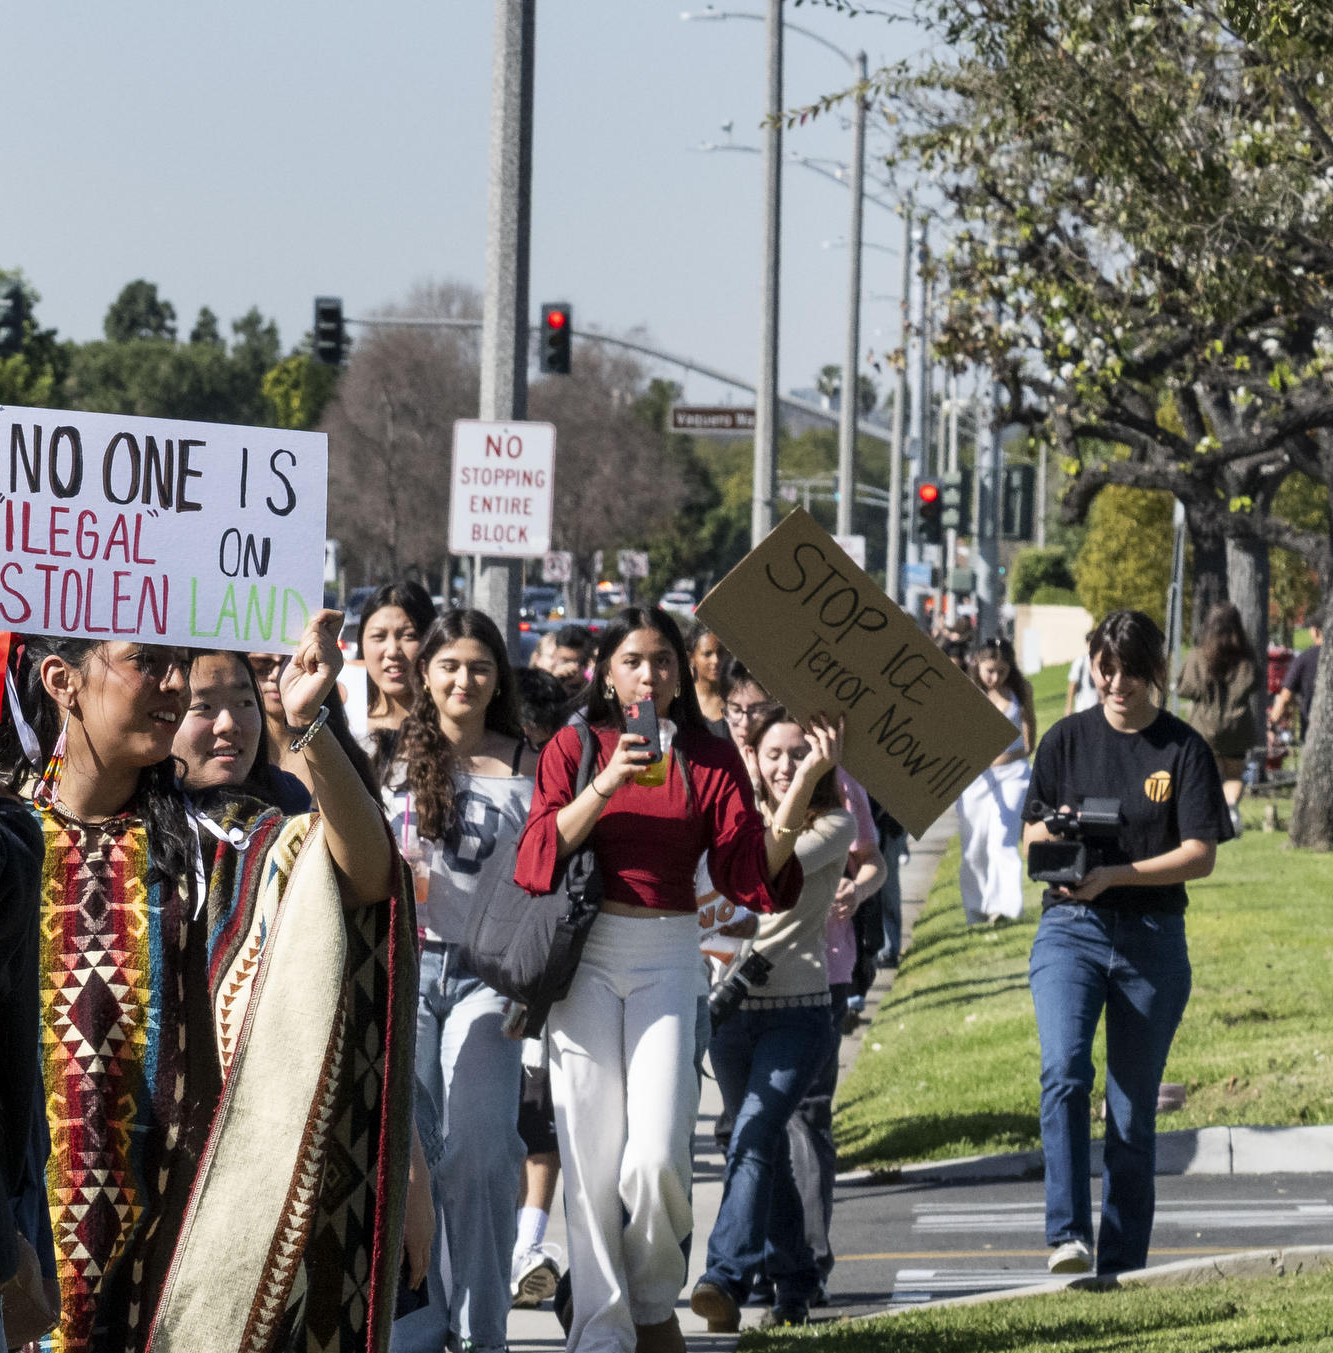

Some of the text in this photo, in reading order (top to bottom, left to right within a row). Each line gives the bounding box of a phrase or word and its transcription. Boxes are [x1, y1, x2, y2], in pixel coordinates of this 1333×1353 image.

[9, 423, 297, 517] NO ONE IS
[485, 434, 523, 459] NO
[460, 466, 546, 489] STOPPING
[470, 495, 533, 516] ENTIRE
[219, 527, 272, 578] ON
[471, 523, 529, 544] BLOCK
[189, 577, 310, 646] LAND
[765, 543, 889, 644] STOP
[879, 643, 946, 706] ICE
[793, 630, 877, 709] Terror
